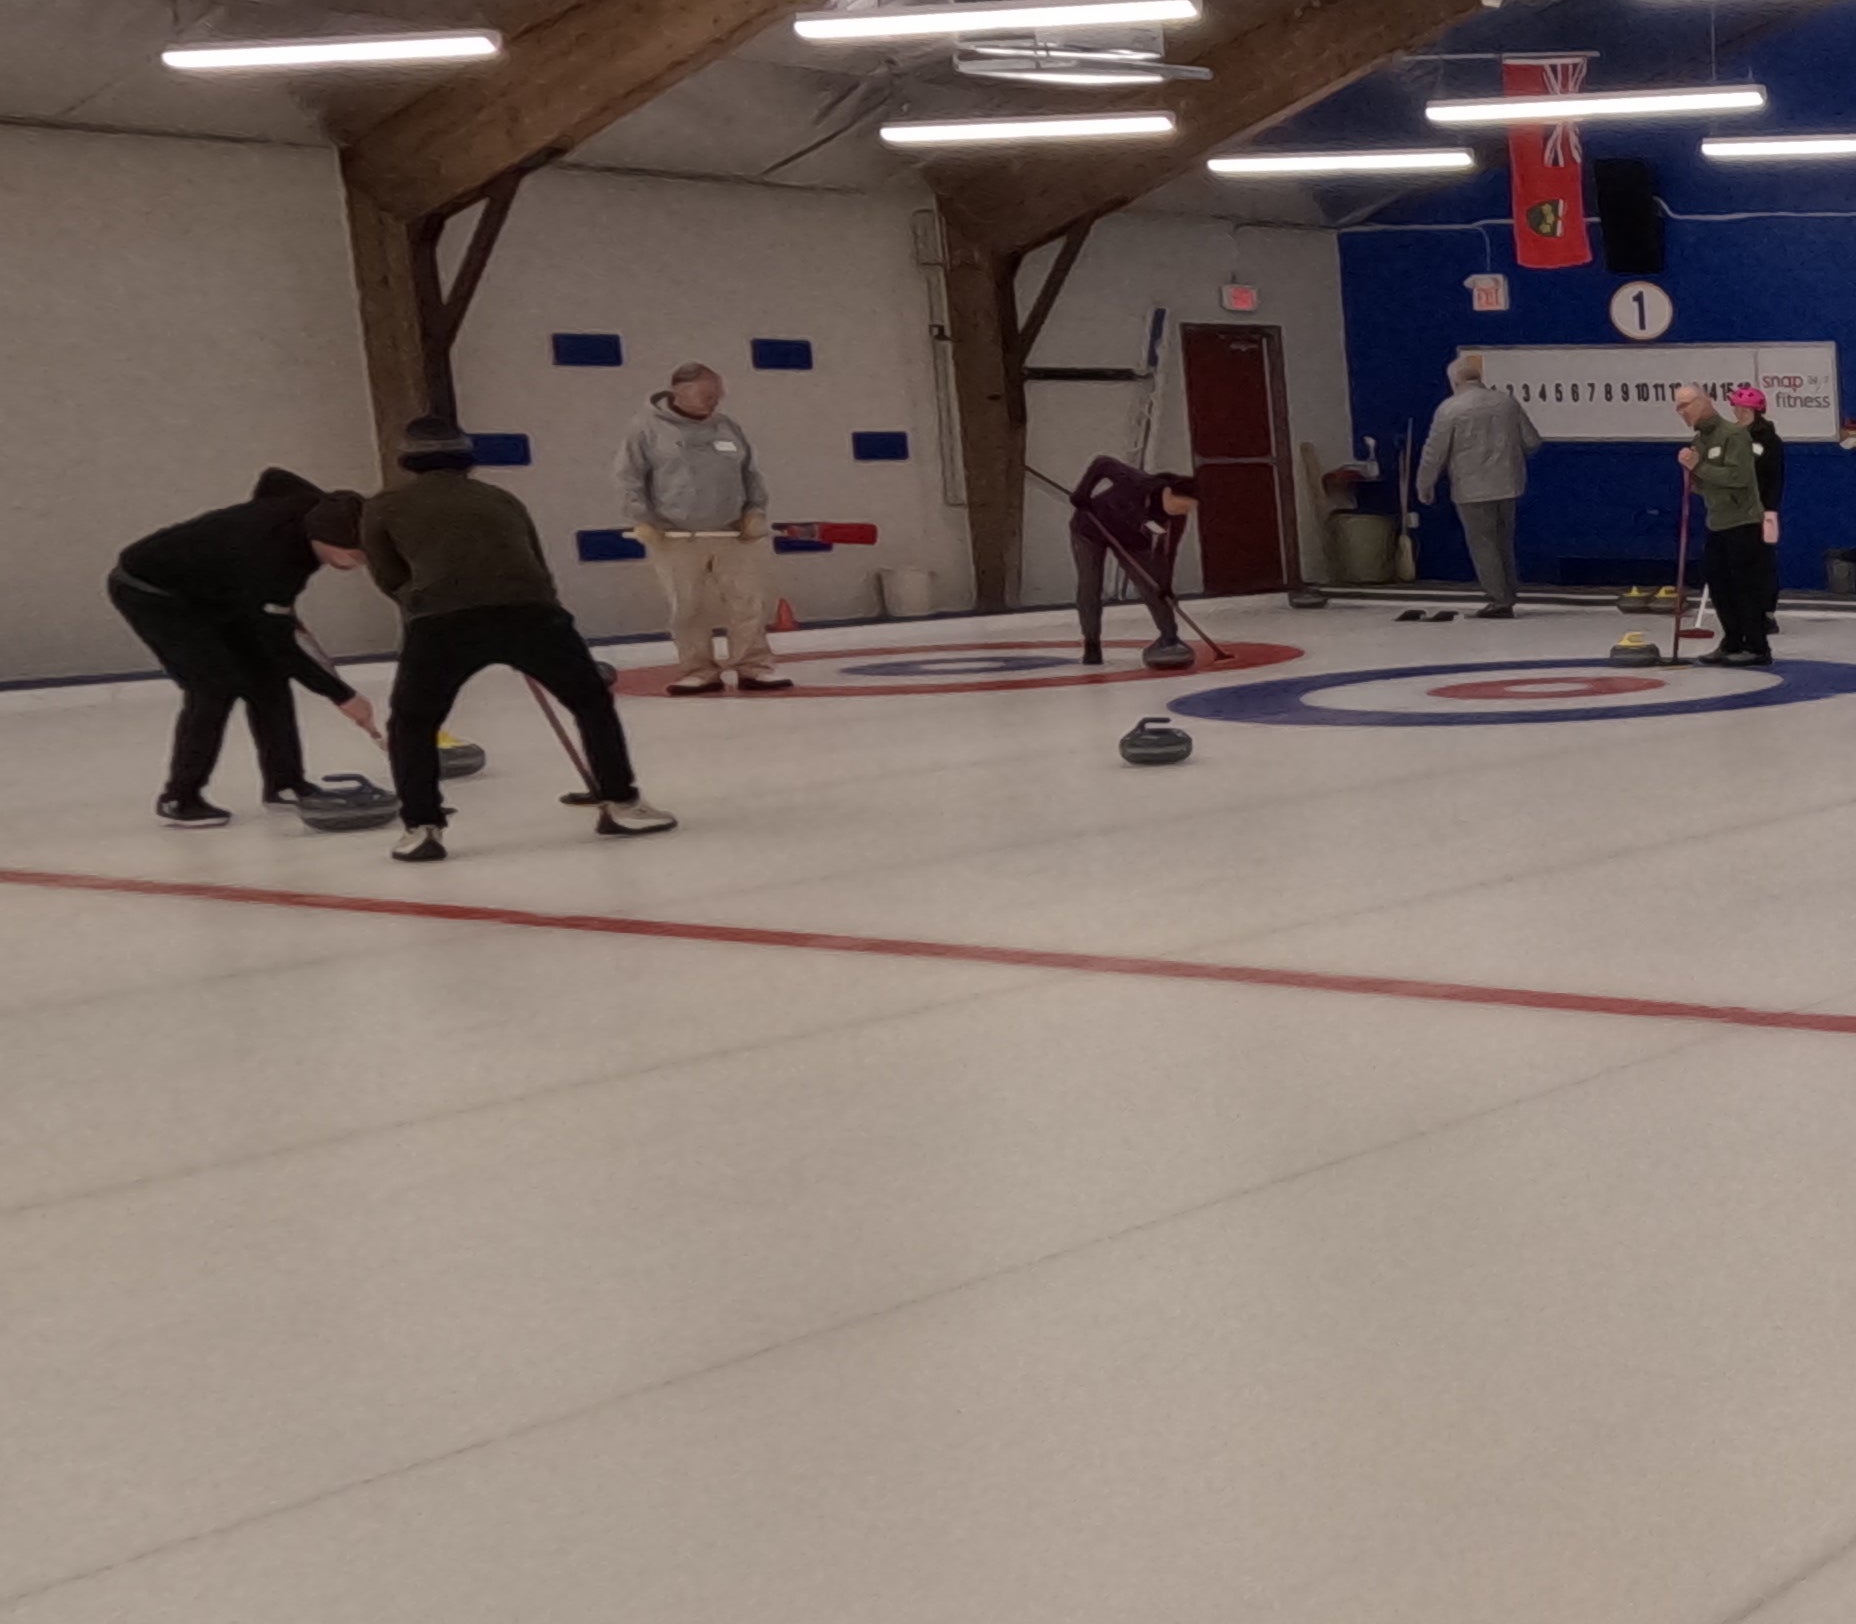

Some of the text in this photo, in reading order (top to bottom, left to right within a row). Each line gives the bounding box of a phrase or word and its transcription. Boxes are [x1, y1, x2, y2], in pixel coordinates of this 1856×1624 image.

[1632, 290, 1646, 331] 1
[1521, 382, 1531, 403] 3
[1538, 382, 1547, 403] 4
[1554, 382, 1564, 403] 5
[1570, 382, 1580, 403] 6
[1587, 382, 1596, 402] 7
[1604, 382, 1614, 403] 8
[1620, 382, 1630, 403] 9
[1634, 382, 1650, 402] 10
[1652, 382, 1667, 402] 11
[1762, 375, 1804, 393] snap
[1775, 391, 1831, 409] fitness
